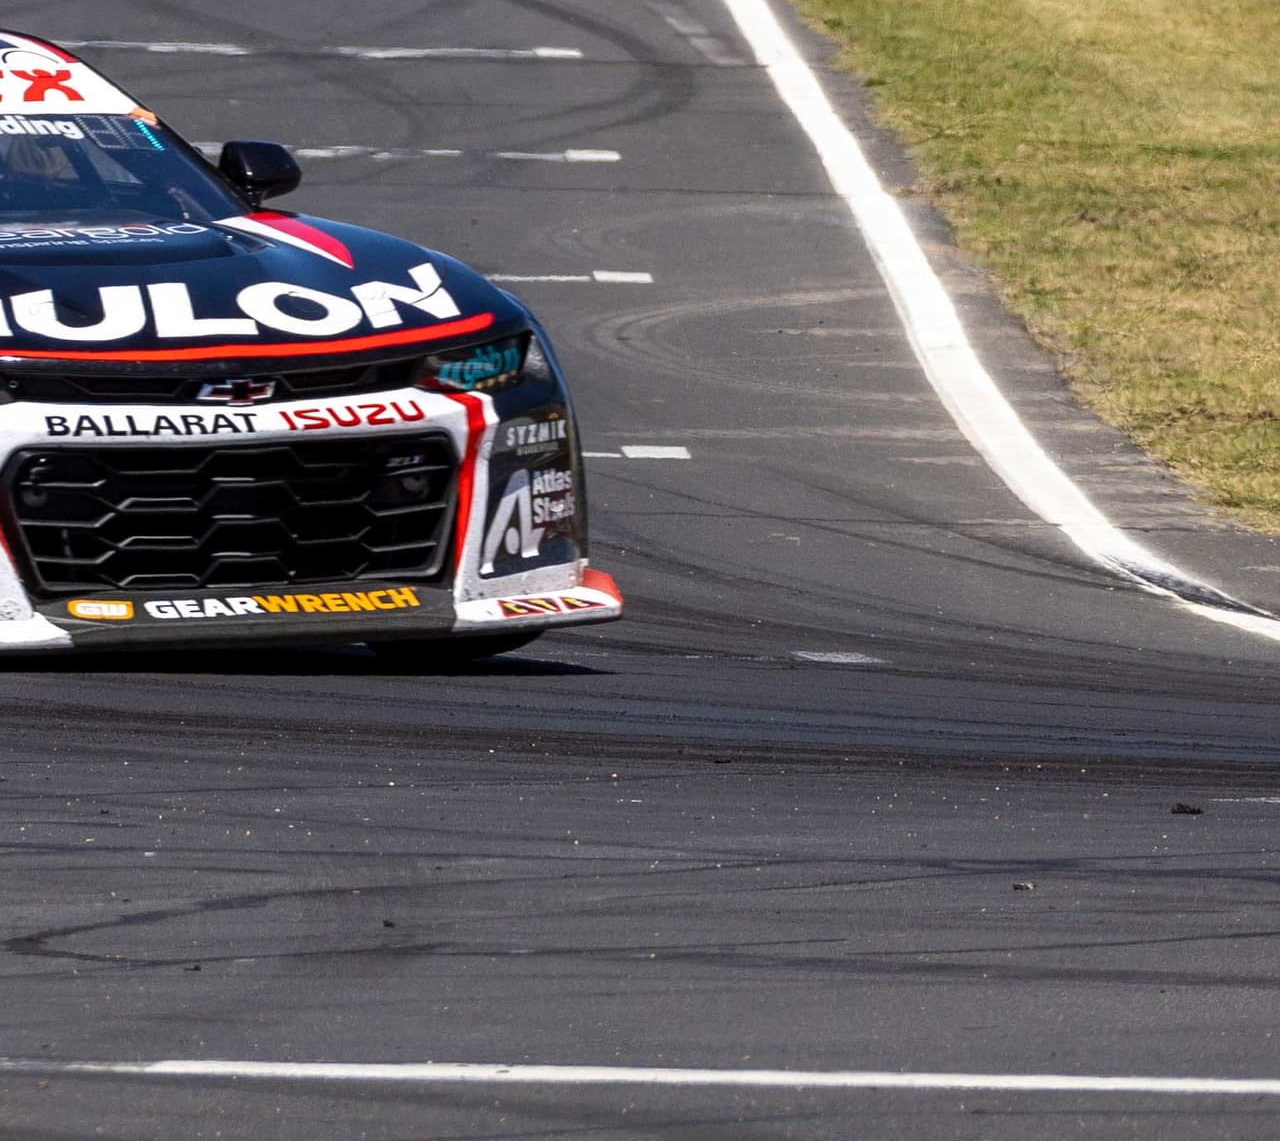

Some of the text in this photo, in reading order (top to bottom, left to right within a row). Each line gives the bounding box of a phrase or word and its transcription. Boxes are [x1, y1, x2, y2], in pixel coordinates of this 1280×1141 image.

[45, 399, 426, 437] BALLARAT ISUZU
[505, 418, 567, 448] SYZMIK
[531, 468, 573, 496] Atlas
[143, 586, 420, 619] GEARWRENCH
